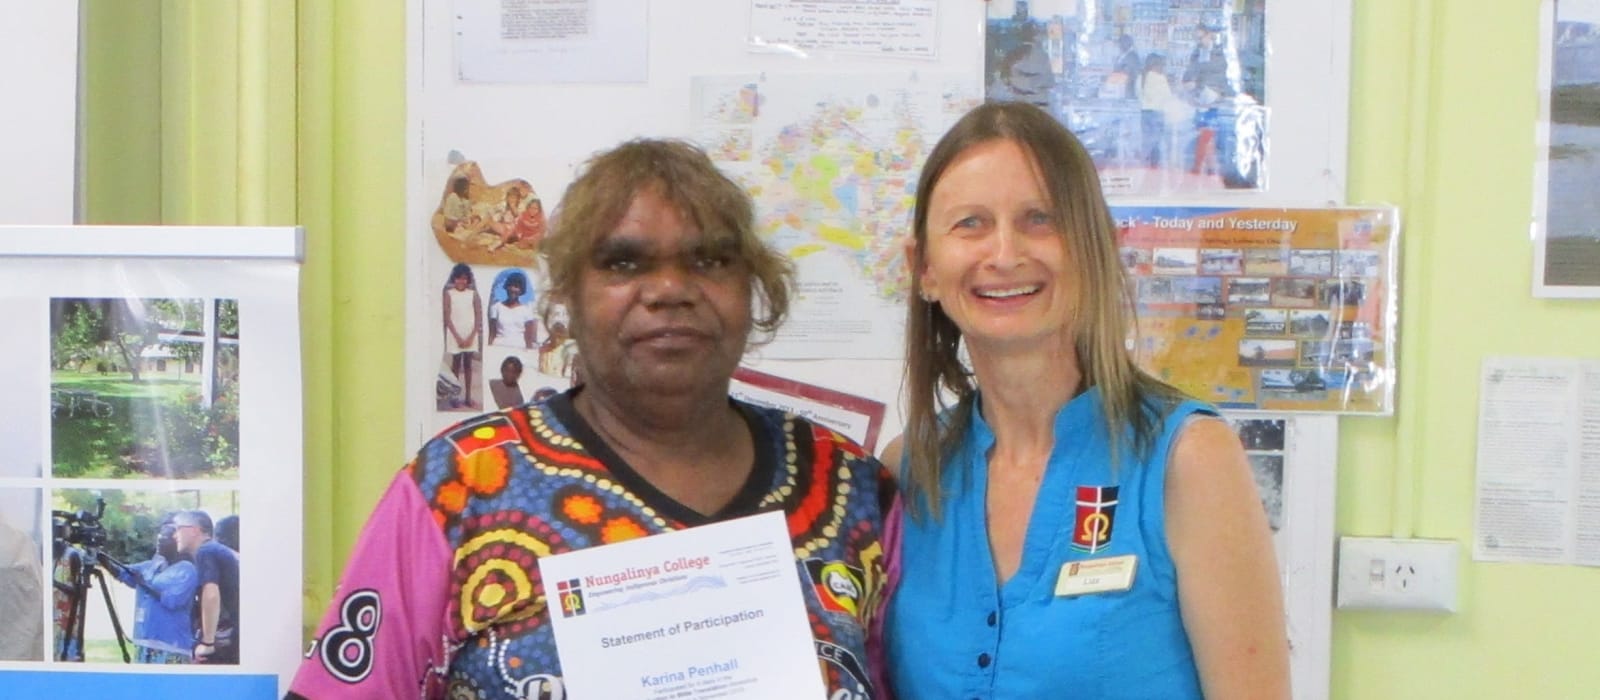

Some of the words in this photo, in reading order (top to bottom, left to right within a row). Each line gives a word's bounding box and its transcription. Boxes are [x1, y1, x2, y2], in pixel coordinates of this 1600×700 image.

[1153, 215, 1194, 231] Today
[1198, 217, 1224, 229] and
[1229, 217, 1298, 233] Yesterday
[585, 566, 660, 588] Nungalinya
[664, 555, 711, 573] College
[601, 627, 666, 649] Statement
[668, 623, 681, 636] of
[684, 607, 764, 633] Participation
[641, 670, 685, 688] Karina
[688, 658, 738, 679] Penhall
